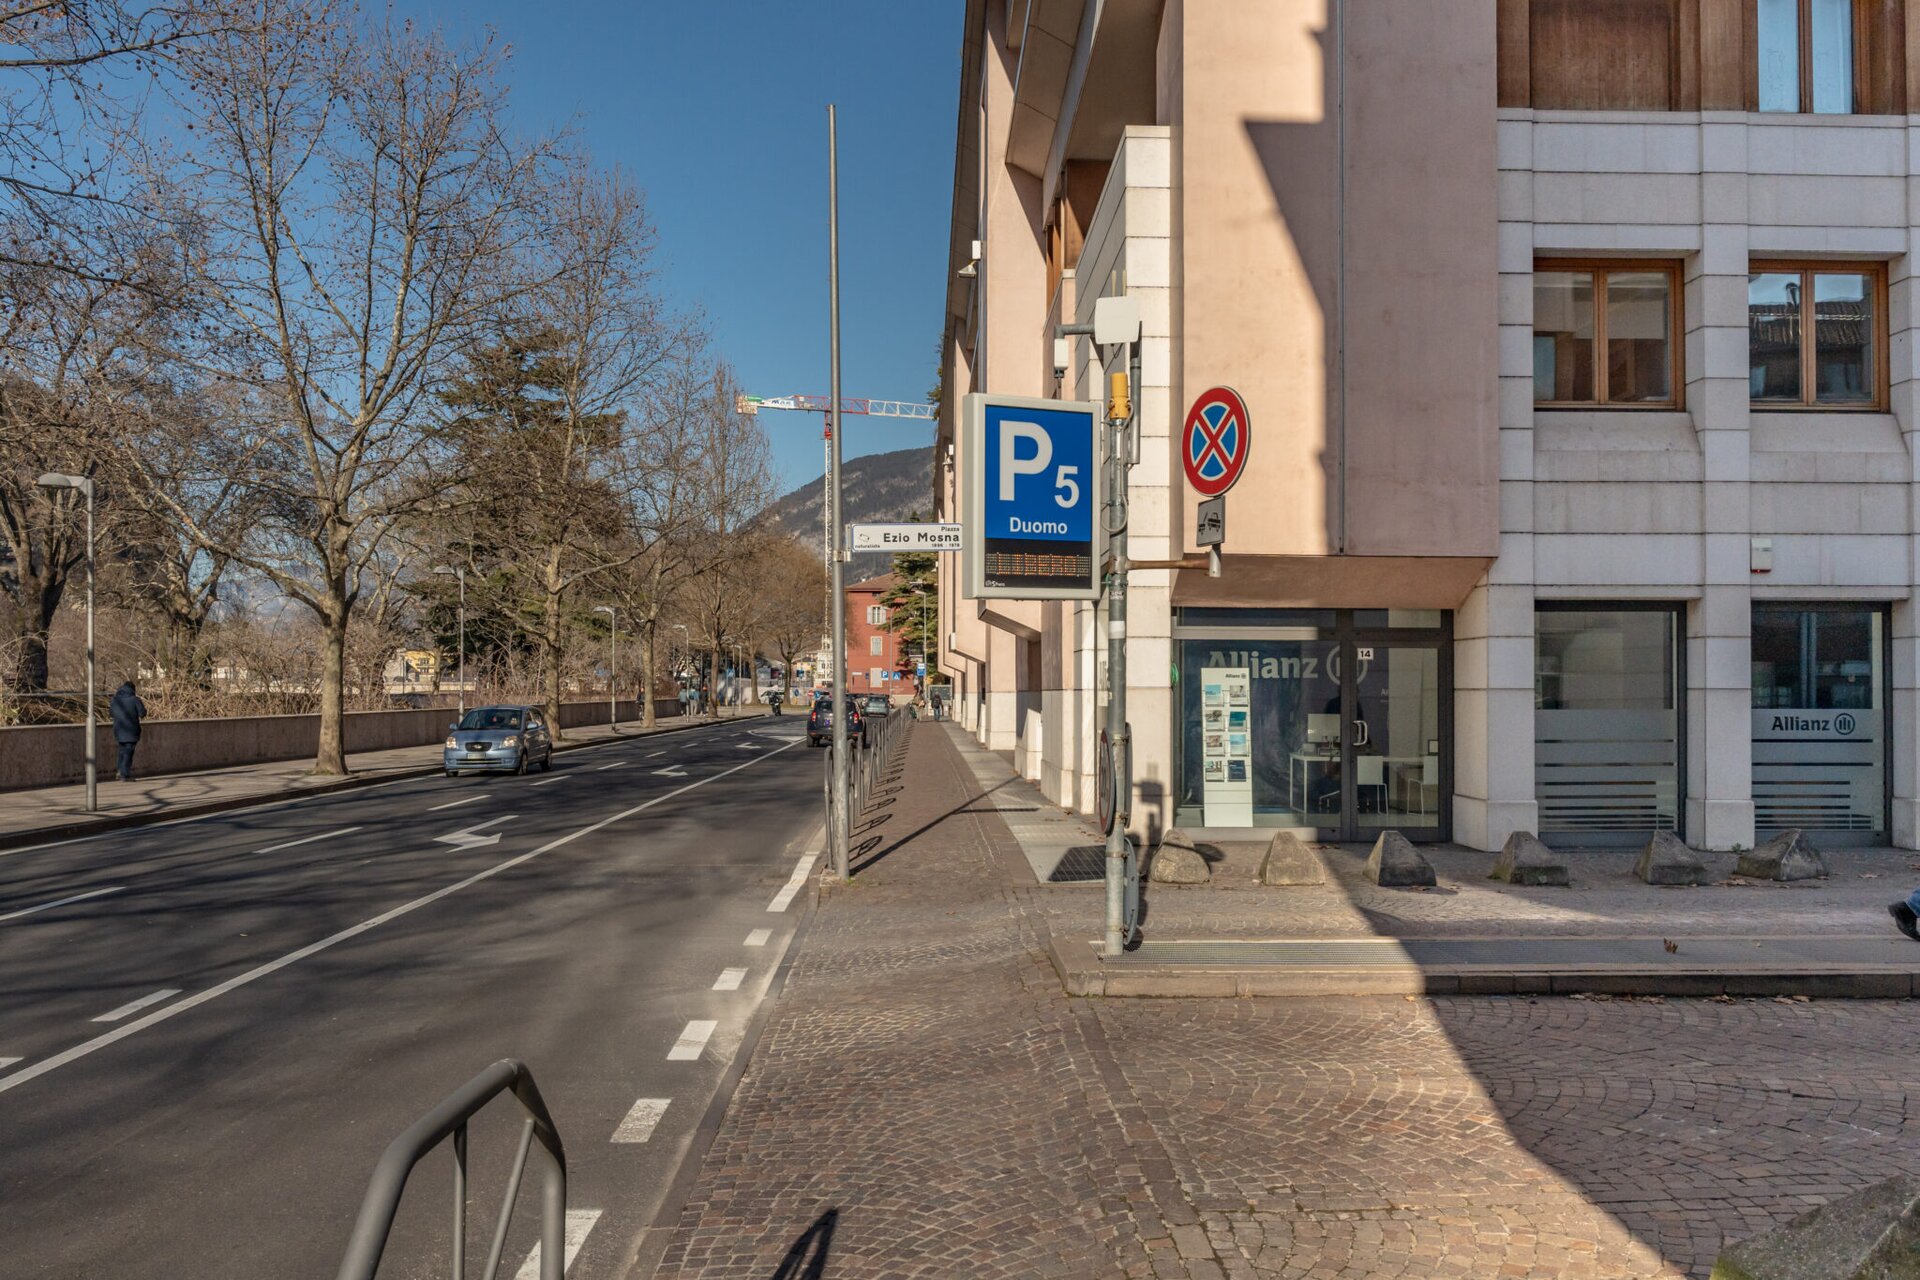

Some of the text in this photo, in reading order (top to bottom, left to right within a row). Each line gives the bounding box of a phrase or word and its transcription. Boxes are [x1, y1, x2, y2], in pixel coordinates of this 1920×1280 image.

[999, 420, 1080, 509] P 5
[1009, 517, 1068, 535] Duomo
[883, 532, 960, 542] Ezio Mosna
[1359, 650, 1371, 658] 14
[1208, 651, 1318, 679] Allianz
[1771, 716, 1830, 731] Allianz
